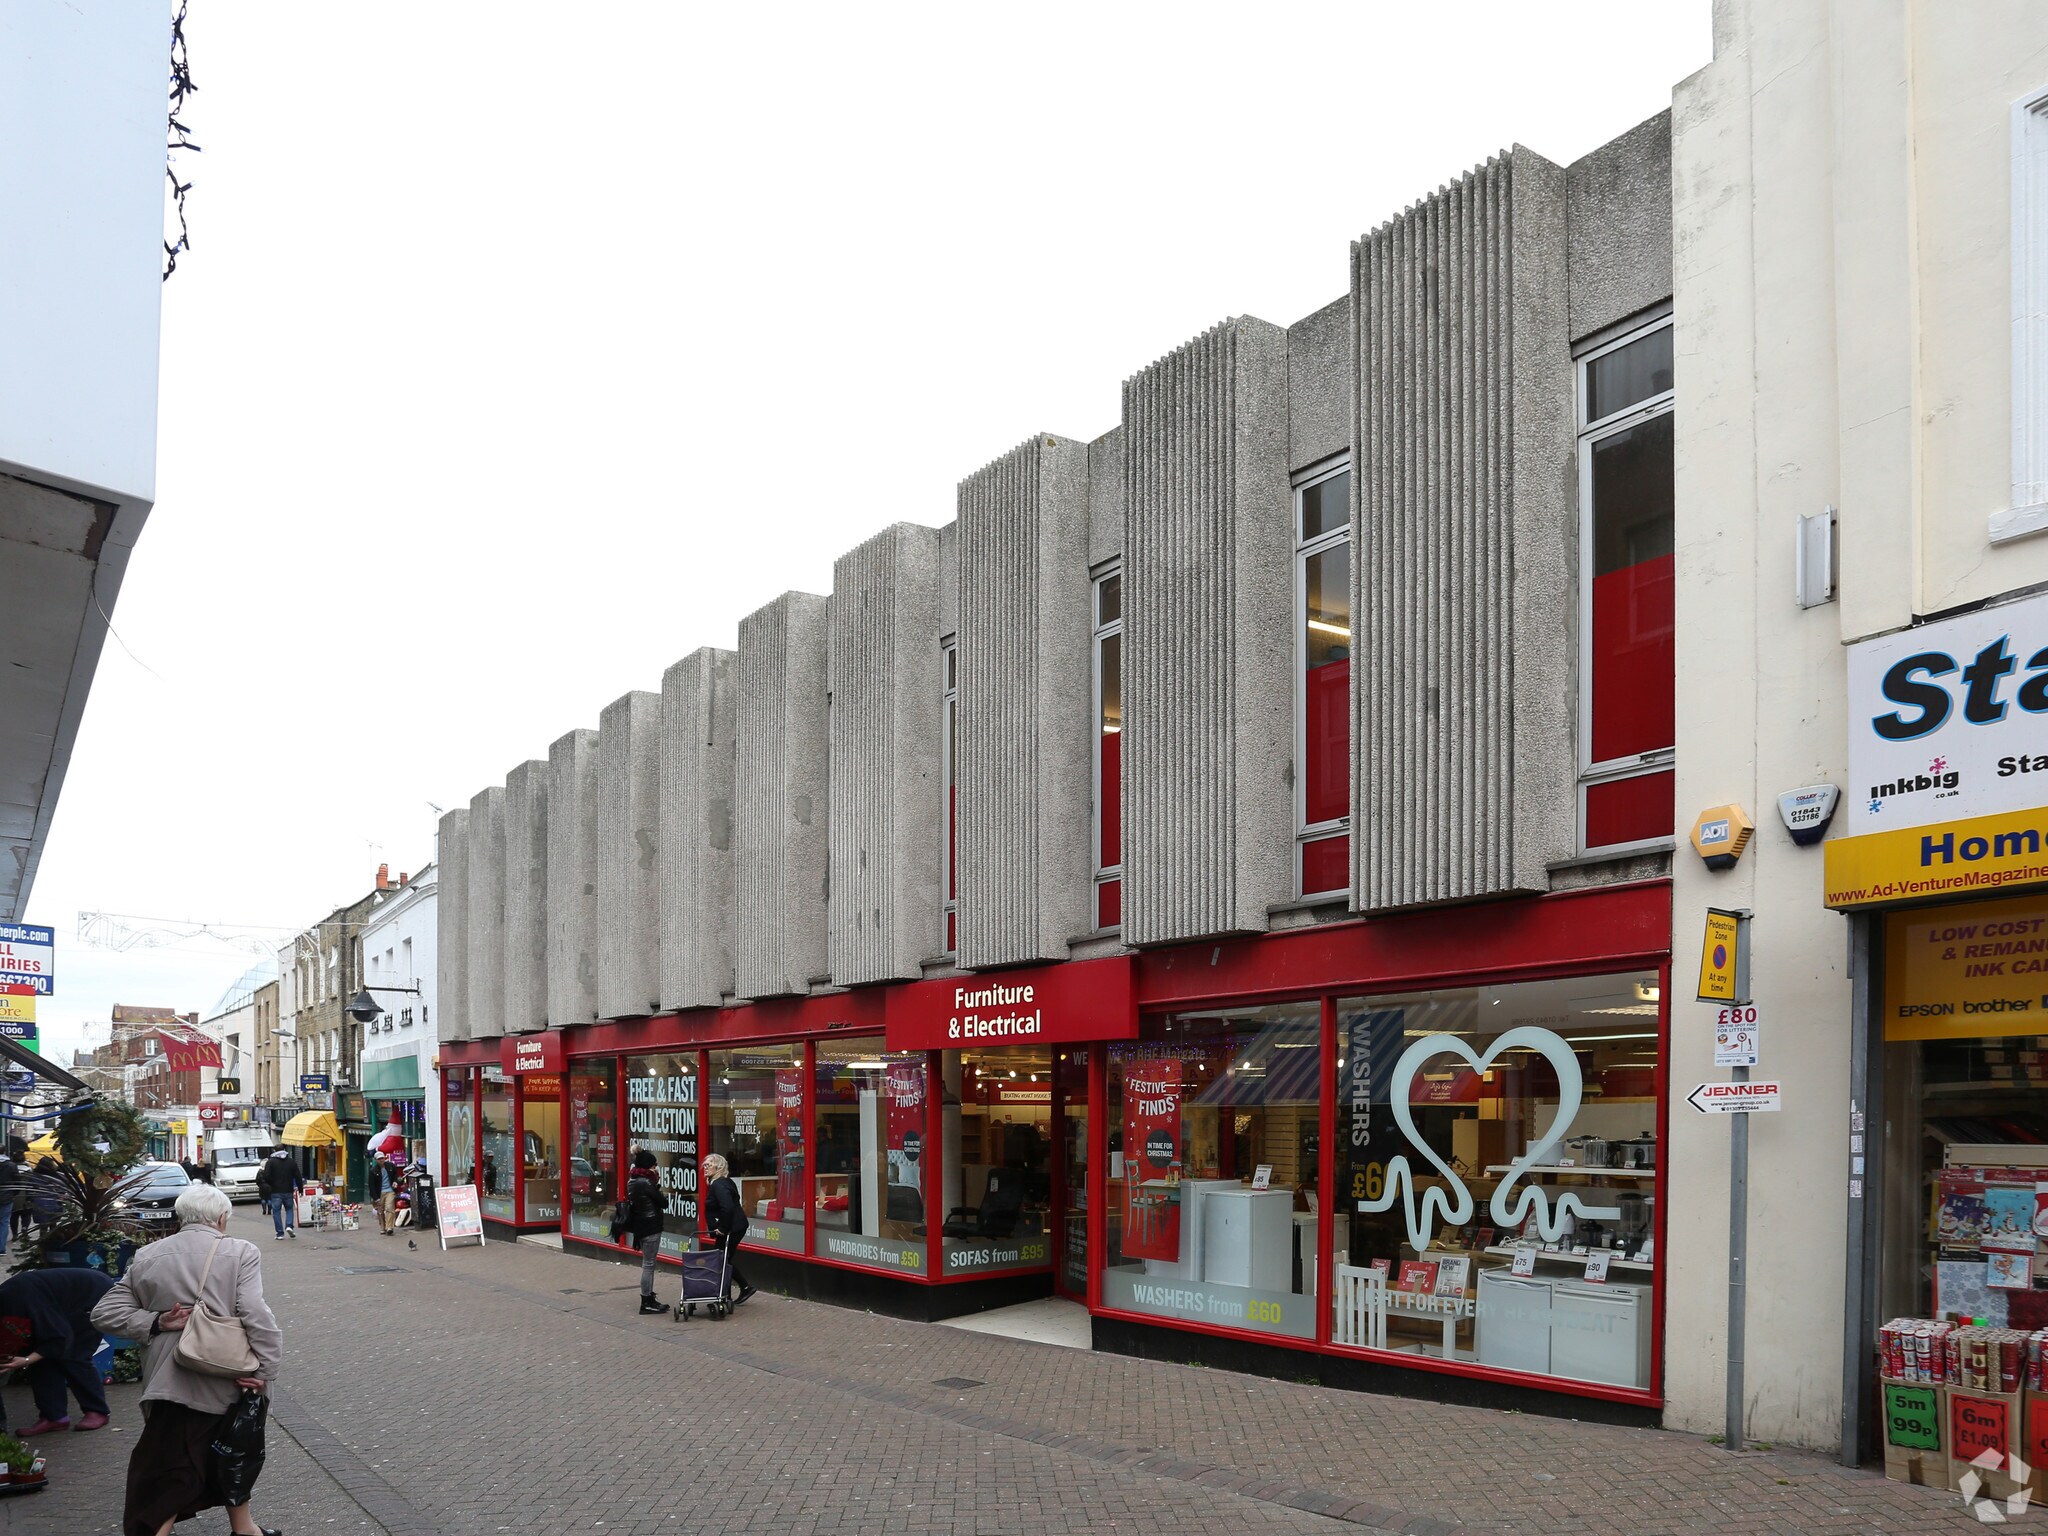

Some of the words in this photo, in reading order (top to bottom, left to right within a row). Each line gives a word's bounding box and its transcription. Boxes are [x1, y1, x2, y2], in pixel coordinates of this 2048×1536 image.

[1790, 806, 1821, 816] 01843
[1791, 812, 1820, 823] 833186
[1701, 823, 1729, 841] ADT
[1920, 829, 2048, 867] Hom
[1708, 919, 1735, 931] Pedestrian
[1929, 926, 1979, 943] LOW
[1982, 919, 2045, 938] COST
[1714, 931, 1728, 941] Zone
[1941, 947, 1957, 961] &
[1708, 972, 1716, 981] At
[1717, 974, 1727, 983] any
[1965, 962, 2006, 978] INK
[955, 983, 1034, 1009] Furniture
[1711, 984, 1724, 993] time
[1899, 1003, 1955, 1017] EPSON
[1963, 998, 2032, 1014] brother
[948, 1017, 960, 1039] &
[964, 1009, 1040, 1038] Electrical
[1717, 1008, 1757, 1024] £80
[516, 1040, 542, 1054] Furniture
[515, 1058, 521, 1071] &
[521, 1055, 544, 1070] Electrical
[1161, 1047, 1206, 1065] Margate
[630, 1078, 655, 1102] FREE
[656, 1076, 666, 1102] &
[668, 1076, 696, 1102] FAST
[778, 1082, 797, 1093] FESTIVE
[890, 1078, 914, 1090] FESTIVE
[1129, 1079, 1166, 1094] FESTIVE
[1352, 1021, 1371, 1147] WASHERS
[1703, 1085, 1778, 1096] JENNER
[783, 1095, 802, 1108] FINDS
[895, 1092, 920, 1108] FINDS
[1138, 1096, 1176, 1116] FINDS
[630, 1107, 695, 1135] COLLECTION
[736, 1116, 756, 1124] DELIVERY
[734, 1125, 756, 1134] AVAILABLE
[650, 1140, 678, 1153] UNWANTED
[680, 1140, 696, 1154] ITEMS
[1147, 1150, 1173, 1158] CHRISTMAS
[1164, 1142, 1173, 1150] FOR
[1352, 1162, 1365, 1170] From
[672, 1167, 697, 1192] 3000
[538, 1208, 554, 1217] TVs
[751, 1227, 765, 1239] from
[828, 1238, 878, 1260] WARDROBES
[880, 1248, 899, 1264] from
[901, 1251, 920, 1268] £50
[950, 1249, 989, 1268] SOFAS
[992, 1248, 1018, 1263] from
[1021, 1244, 1044, 1260] £95
[1442, 1258, 1461, 1266] BRAND
[1588, 1263, 1600, 1271] £90
[1133, 1284, 1204, 1312] WASHERS
[1208, 1295, 1242, 1318] from
[1248, 1300, 1281, 1324] £60
[1406, 1291, 1438, 1313] FOR
[1895, 1395, 1926, 1411] 5m
[1962, 1408, 1996, 1428] 6m
[1893, 1417, 1932, 1437] 99p
[1961, 1429, 1998, 1448] £1.09
